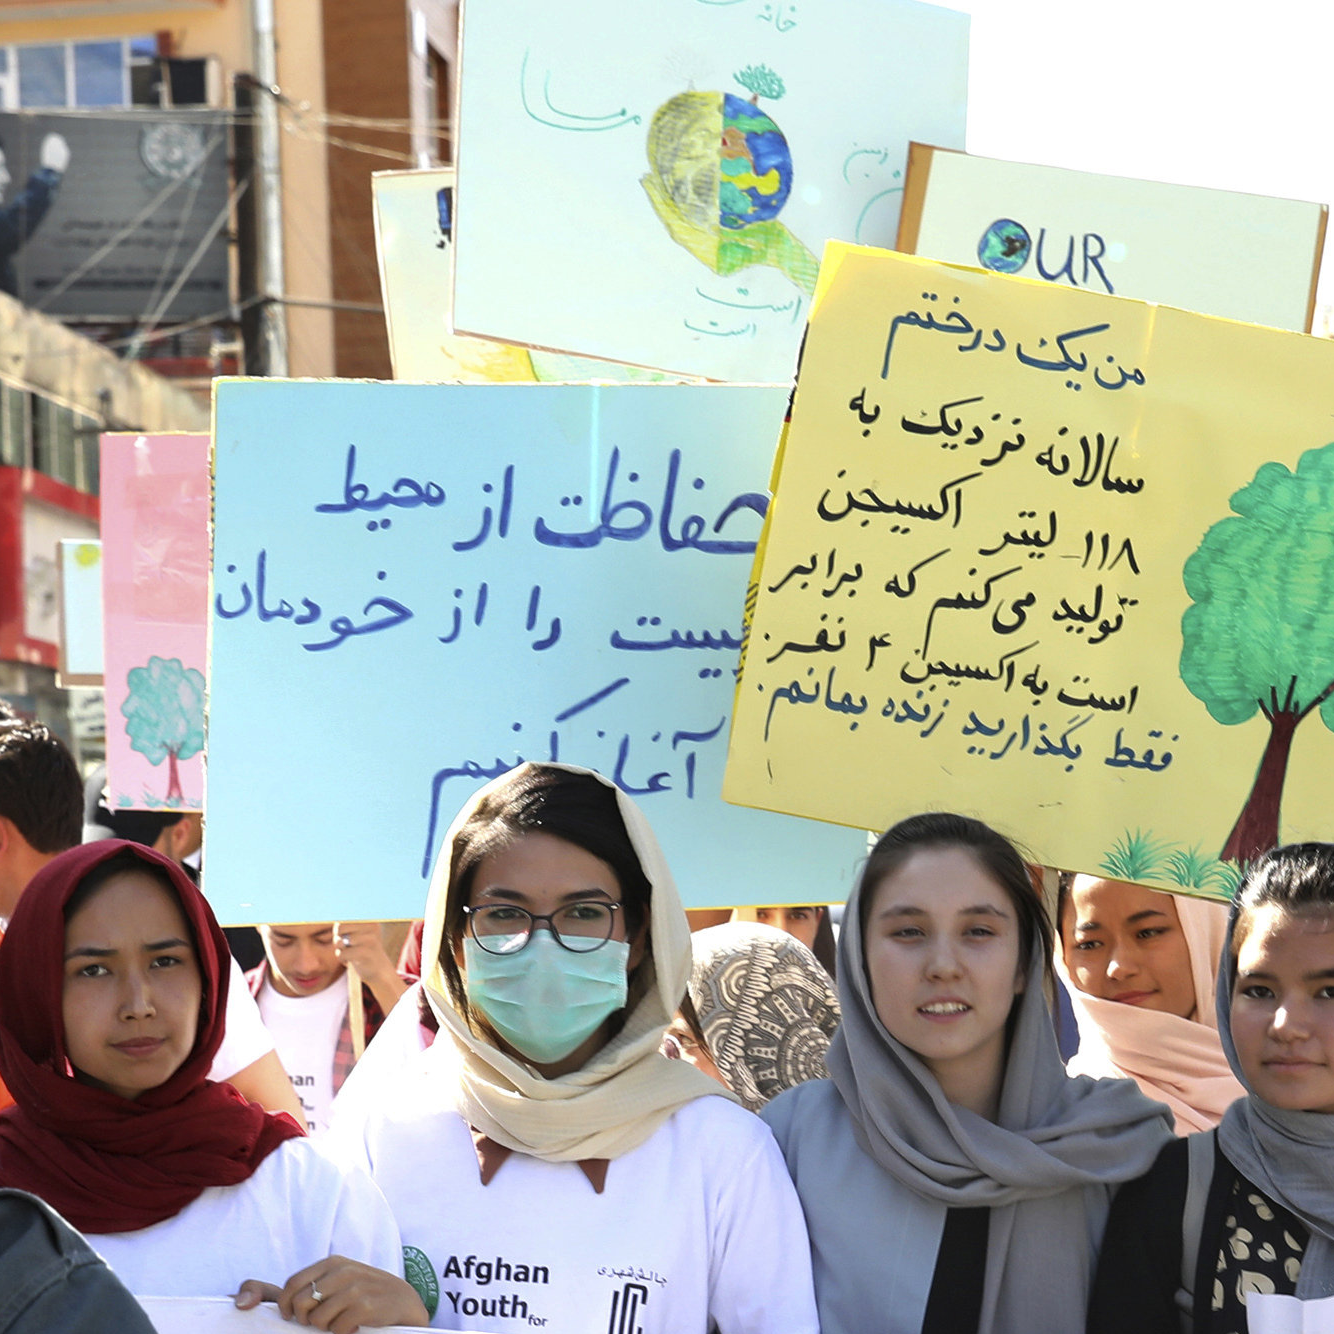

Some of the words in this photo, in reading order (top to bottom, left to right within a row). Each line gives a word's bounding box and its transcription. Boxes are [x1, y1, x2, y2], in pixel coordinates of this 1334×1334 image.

[881, 292, 1007, 379] درختم
[1094, 354, 1146, 389] من
[849, 388, 881, 437] به
[901, 396, 1026, 466] نزدیک
[315, 444, 447, 532] محیط
[1035, 426, 1144, 494] سالانه
[452, 464, 515, 553] از
[817, 470, 984, 535] اکسیجن
[979, 511, 1058, 558] لیتر
[215, 550, 413, 652] خودمان
[768, 549, 863, 597] برابر
[884, 549, 952, 598] که
[440, 581, 488, 644] از
[526, 585, 563, 651] را
[1052, 583, 1139, 644] تولید
[609, 615, 745, 681] یست
[880, 689, 950, 738] زنده
[1021, 664, 1049, 708] به
[1058, 673, 1138, 714] است
[962, 713, 1095, 772] بگذارید
[1104, 727, 1180, 772] فقط
[443, 1255, 550, 1286] Afghan
[444, 1290, 528, 1319] Youth
[528, 1313, 549, 1327] for
